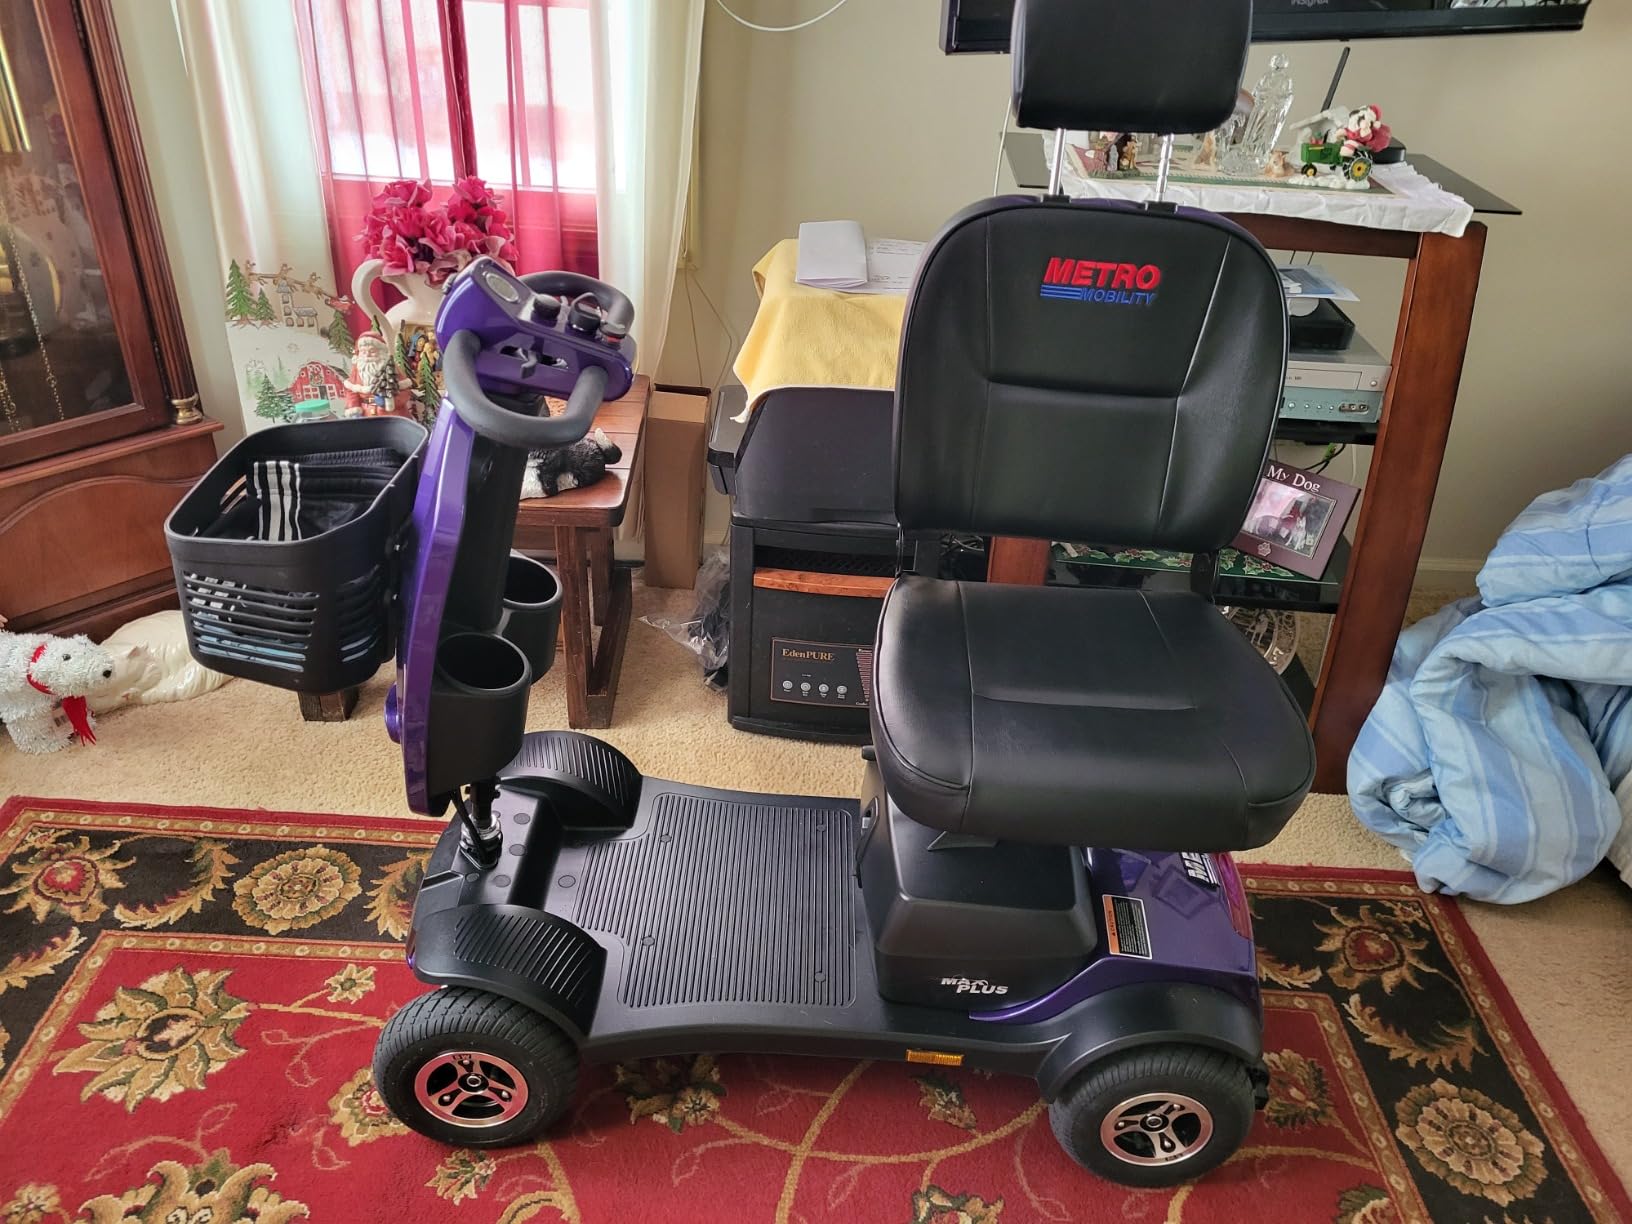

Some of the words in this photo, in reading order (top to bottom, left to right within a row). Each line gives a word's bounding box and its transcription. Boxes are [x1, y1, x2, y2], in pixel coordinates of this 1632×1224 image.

[1043, 257, 1161, 290] METRO
[1080, 287, 1157, 304] MOBILITY
[1292, 473, 1321, 492] Dog
[782, 648, 835, 661] EdenPURE
[941, 977, 988, 985] MAX
[956, 985, 1008, 994] PLUS
